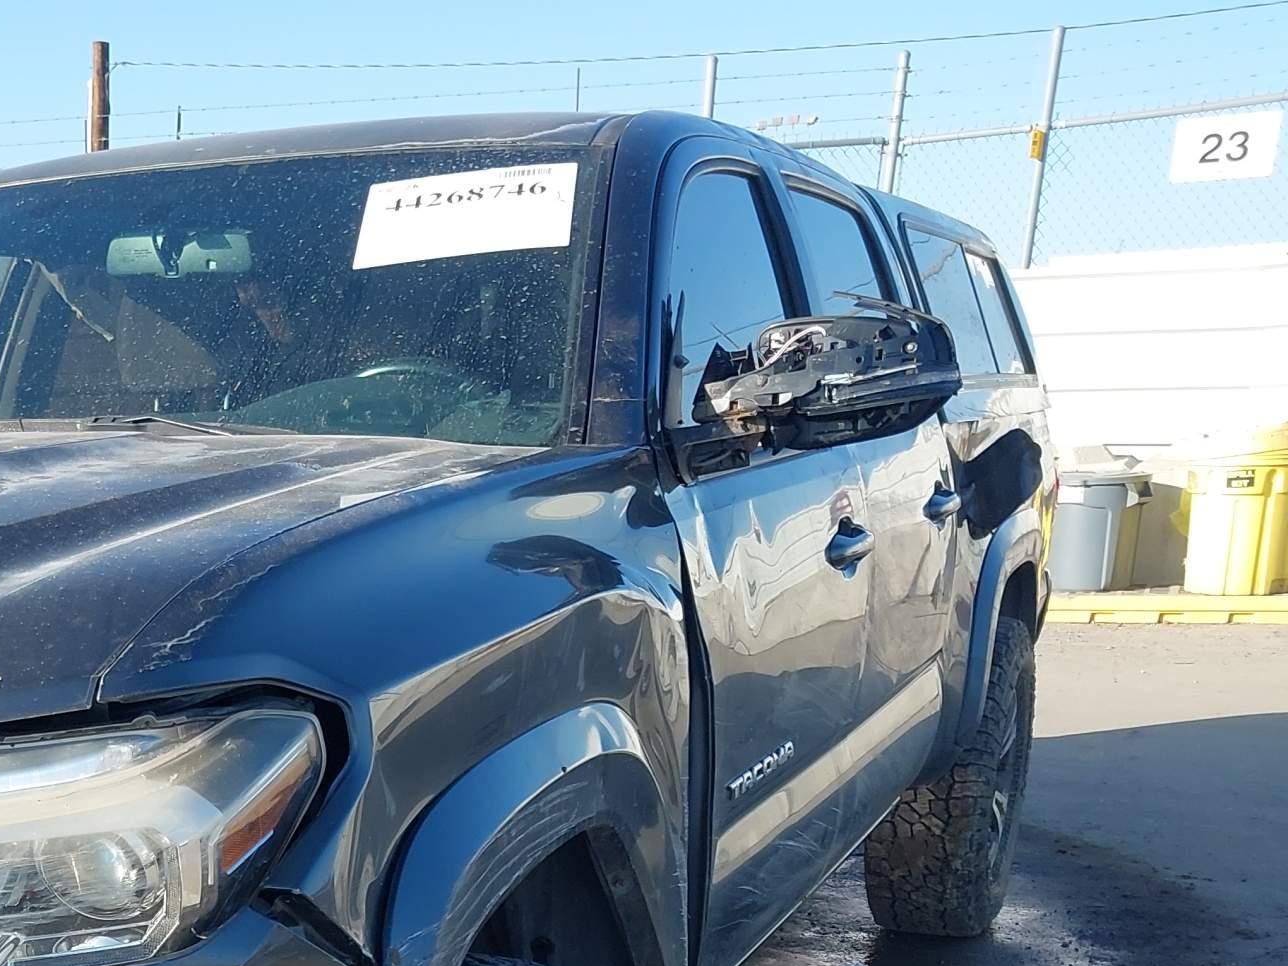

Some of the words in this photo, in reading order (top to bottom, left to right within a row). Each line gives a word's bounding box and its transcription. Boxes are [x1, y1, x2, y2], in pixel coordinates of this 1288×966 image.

[1198, 130, 1250, 164] 23
[385, 181, 547, 212] 44268746
[728, 740, 794, 799] TACOMA
